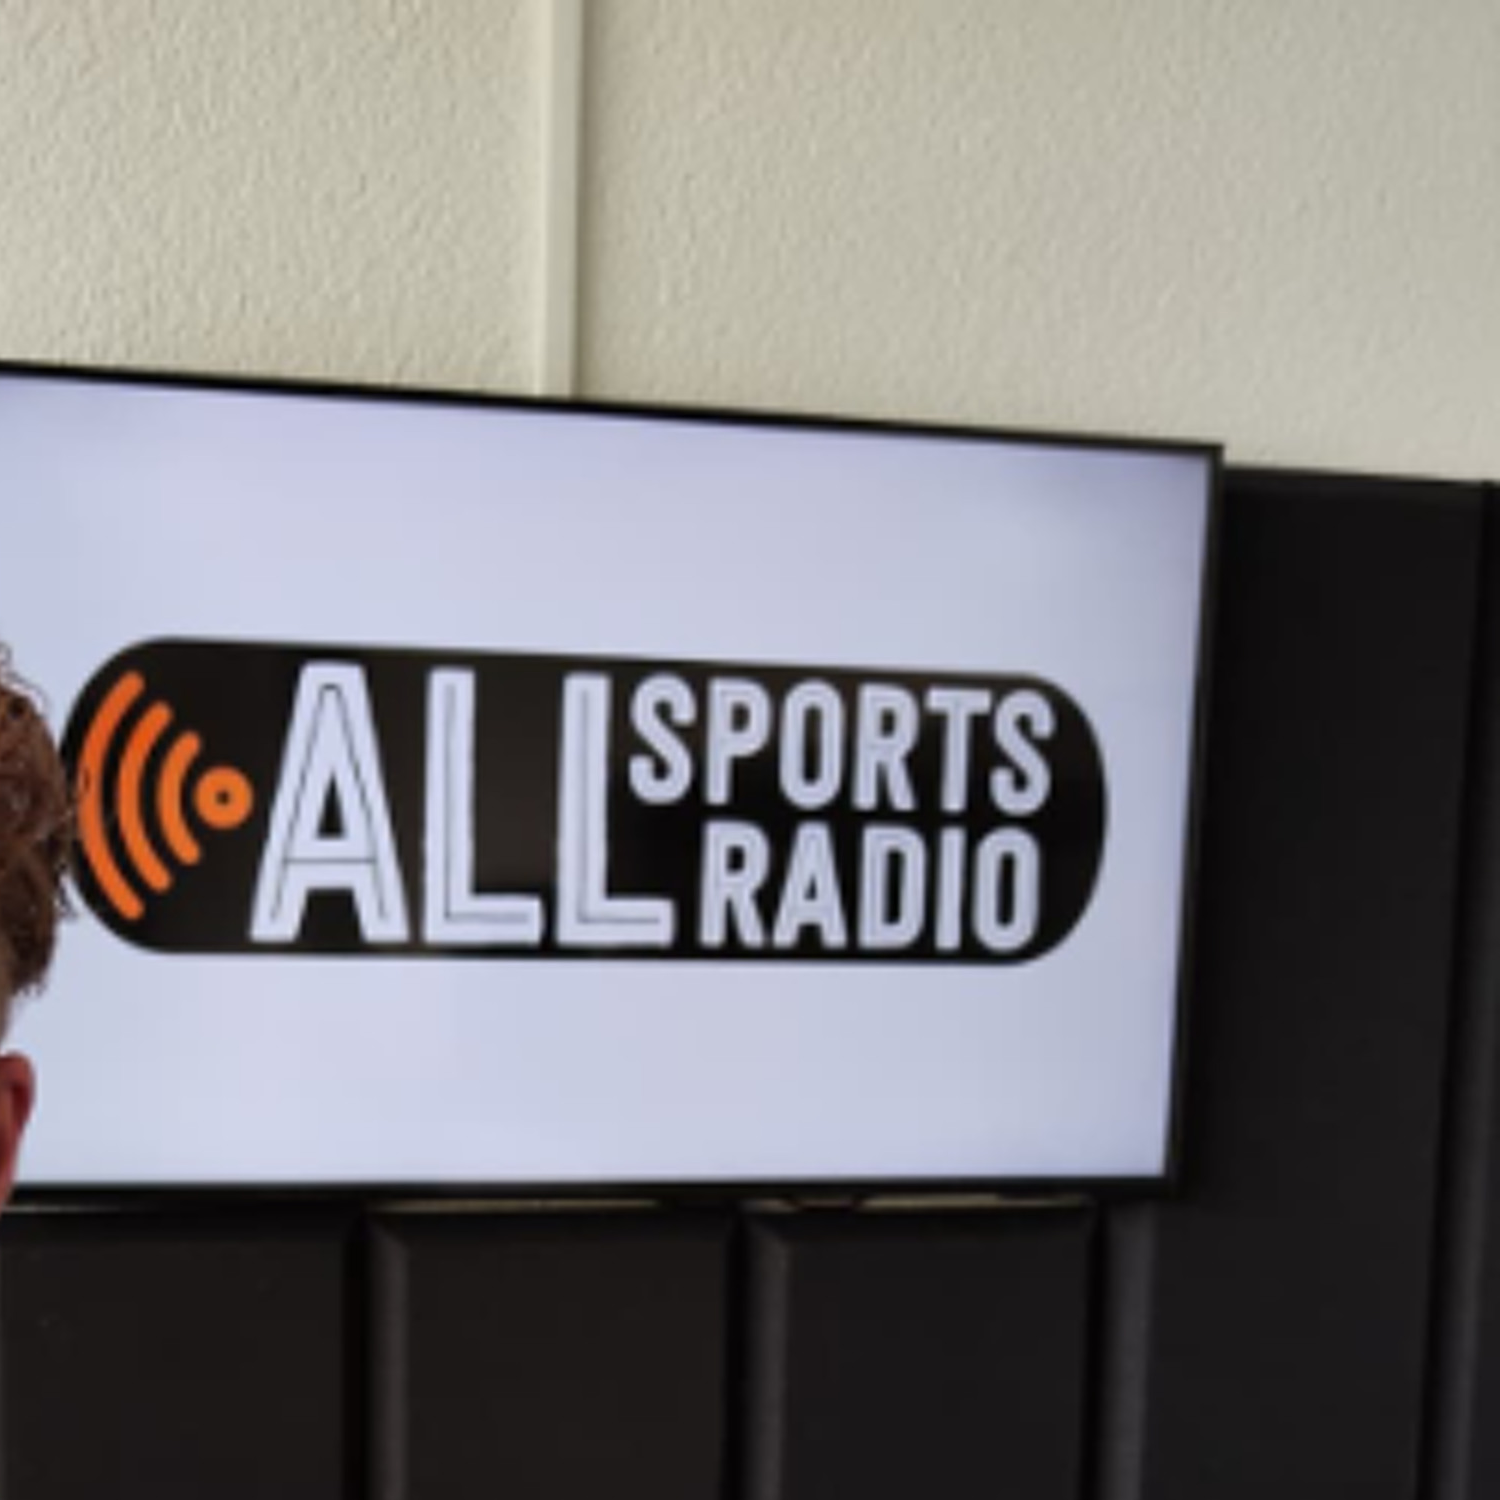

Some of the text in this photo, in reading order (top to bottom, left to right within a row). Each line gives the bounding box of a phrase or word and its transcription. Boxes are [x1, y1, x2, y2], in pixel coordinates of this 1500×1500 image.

[250, 662, 674, 947] ALL
[629, 674, 1054, 815] SPORTS
[700, 821, 1039, 950] RADIO
